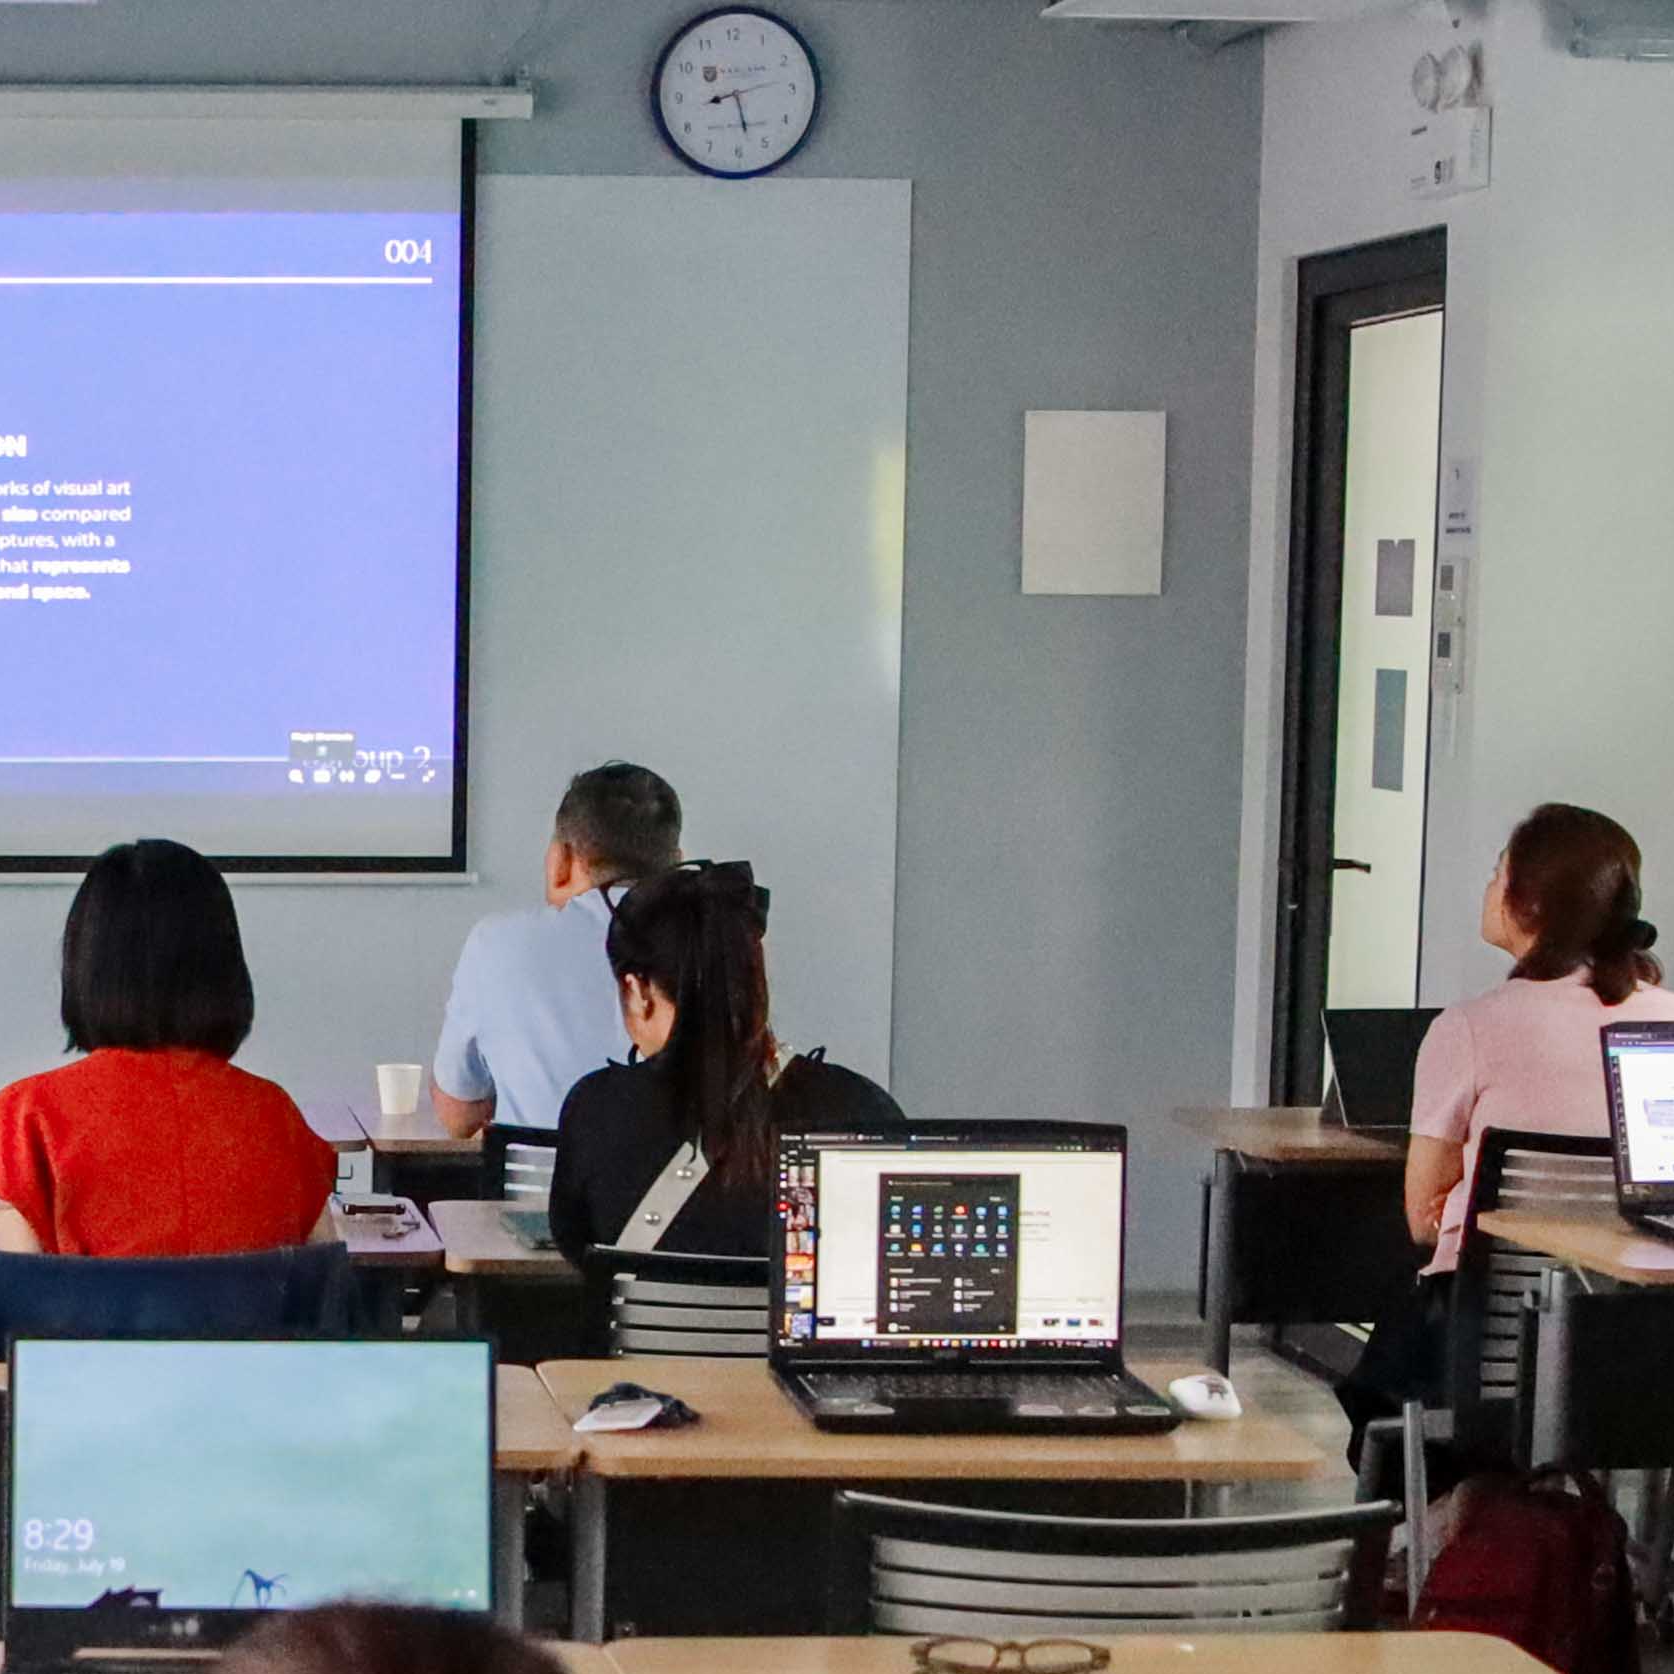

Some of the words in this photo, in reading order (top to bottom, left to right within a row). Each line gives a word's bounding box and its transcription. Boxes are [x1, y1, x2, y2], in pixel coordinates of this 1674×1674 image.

[726, 28, 740, 41] 12
[780, 54, 788, 66] 2
[679, 62, 693, 74] 10
[788, 83, 796, 95] 3
[675, 92, 683, 104] 9
[706, 140, 713, 152] 7
[385, 239, 432, 265] 004
[32, 480, 51, 496] of
[53, 480, 103, 497] visual
[106, 481, 131, 496] art
[41, 506, 131, 524] compared
[61, 532, 102, 548] with
[104, 536, 116, 548] a
[32, 558, 132, 577] represents
[23, 1518, 94, 1552] 8:29
